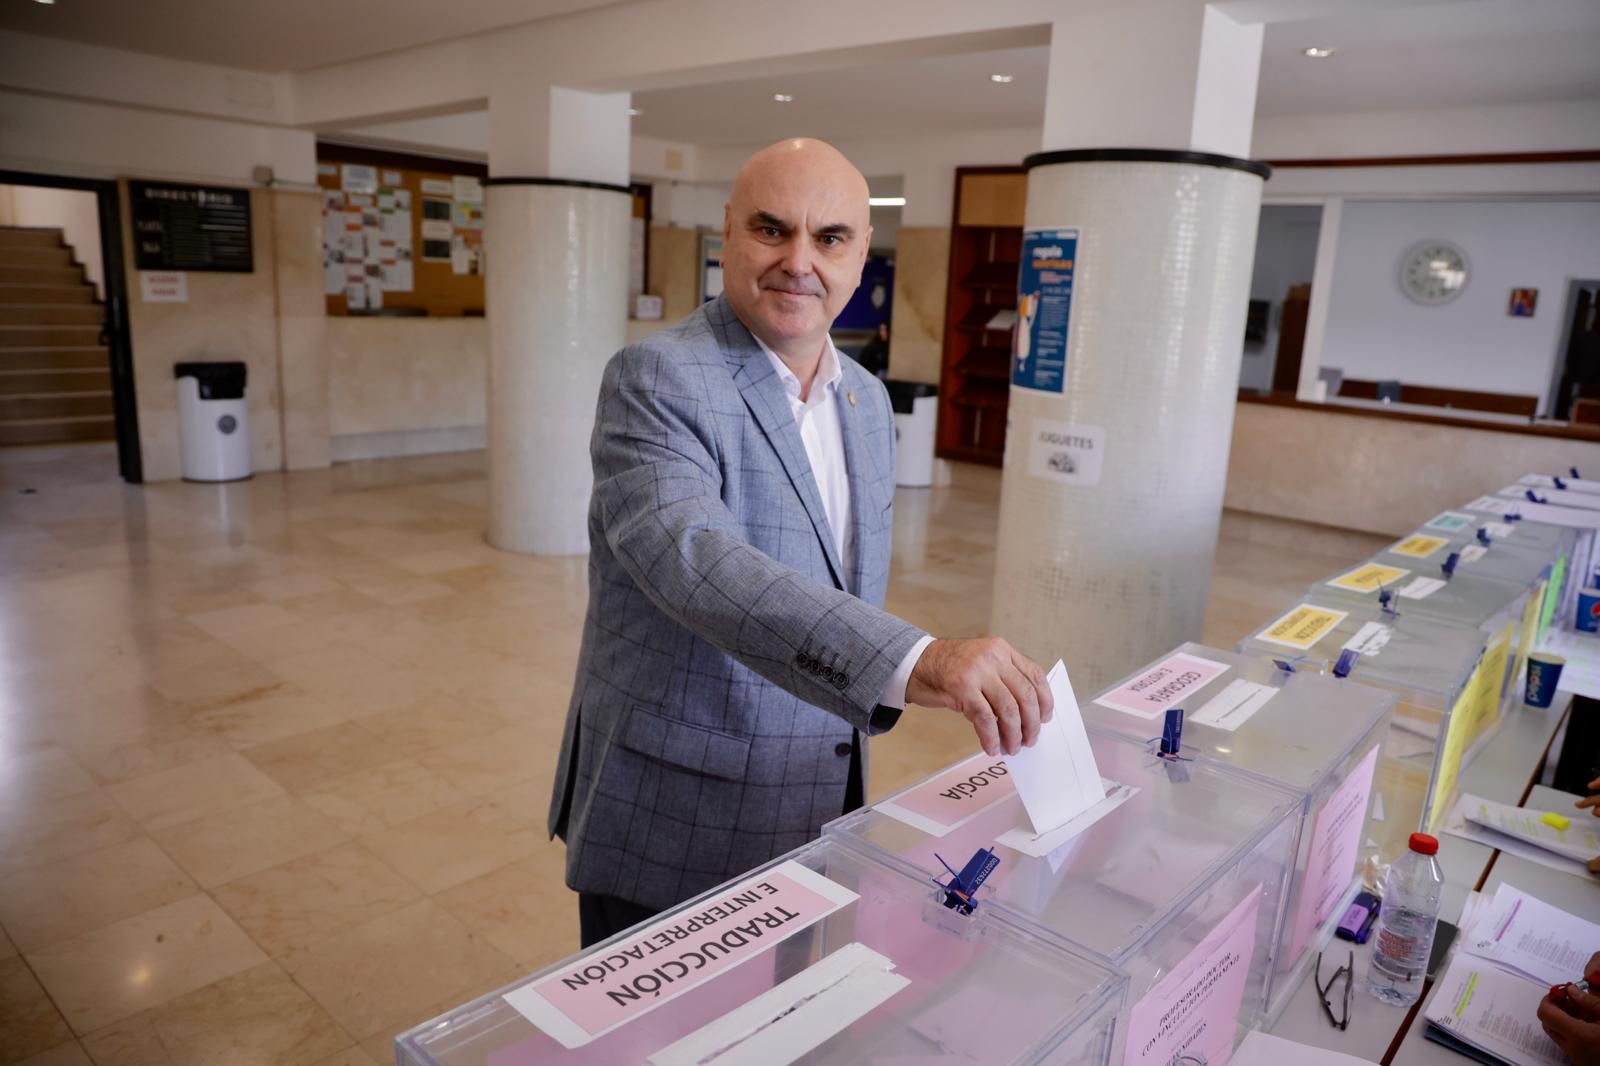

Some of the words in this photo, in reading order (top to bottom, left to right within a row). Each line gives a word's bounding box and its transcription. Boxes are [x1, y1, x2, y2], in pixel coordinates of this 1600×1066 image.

[1144, 671, 1201, 703] GEOGRAFÍA
[757, 882, 779, 895] E
[561, 890, 763, 991] INTERPRETACIÓN
[606, 906, 801, 1007] TRADUCCIÓN
